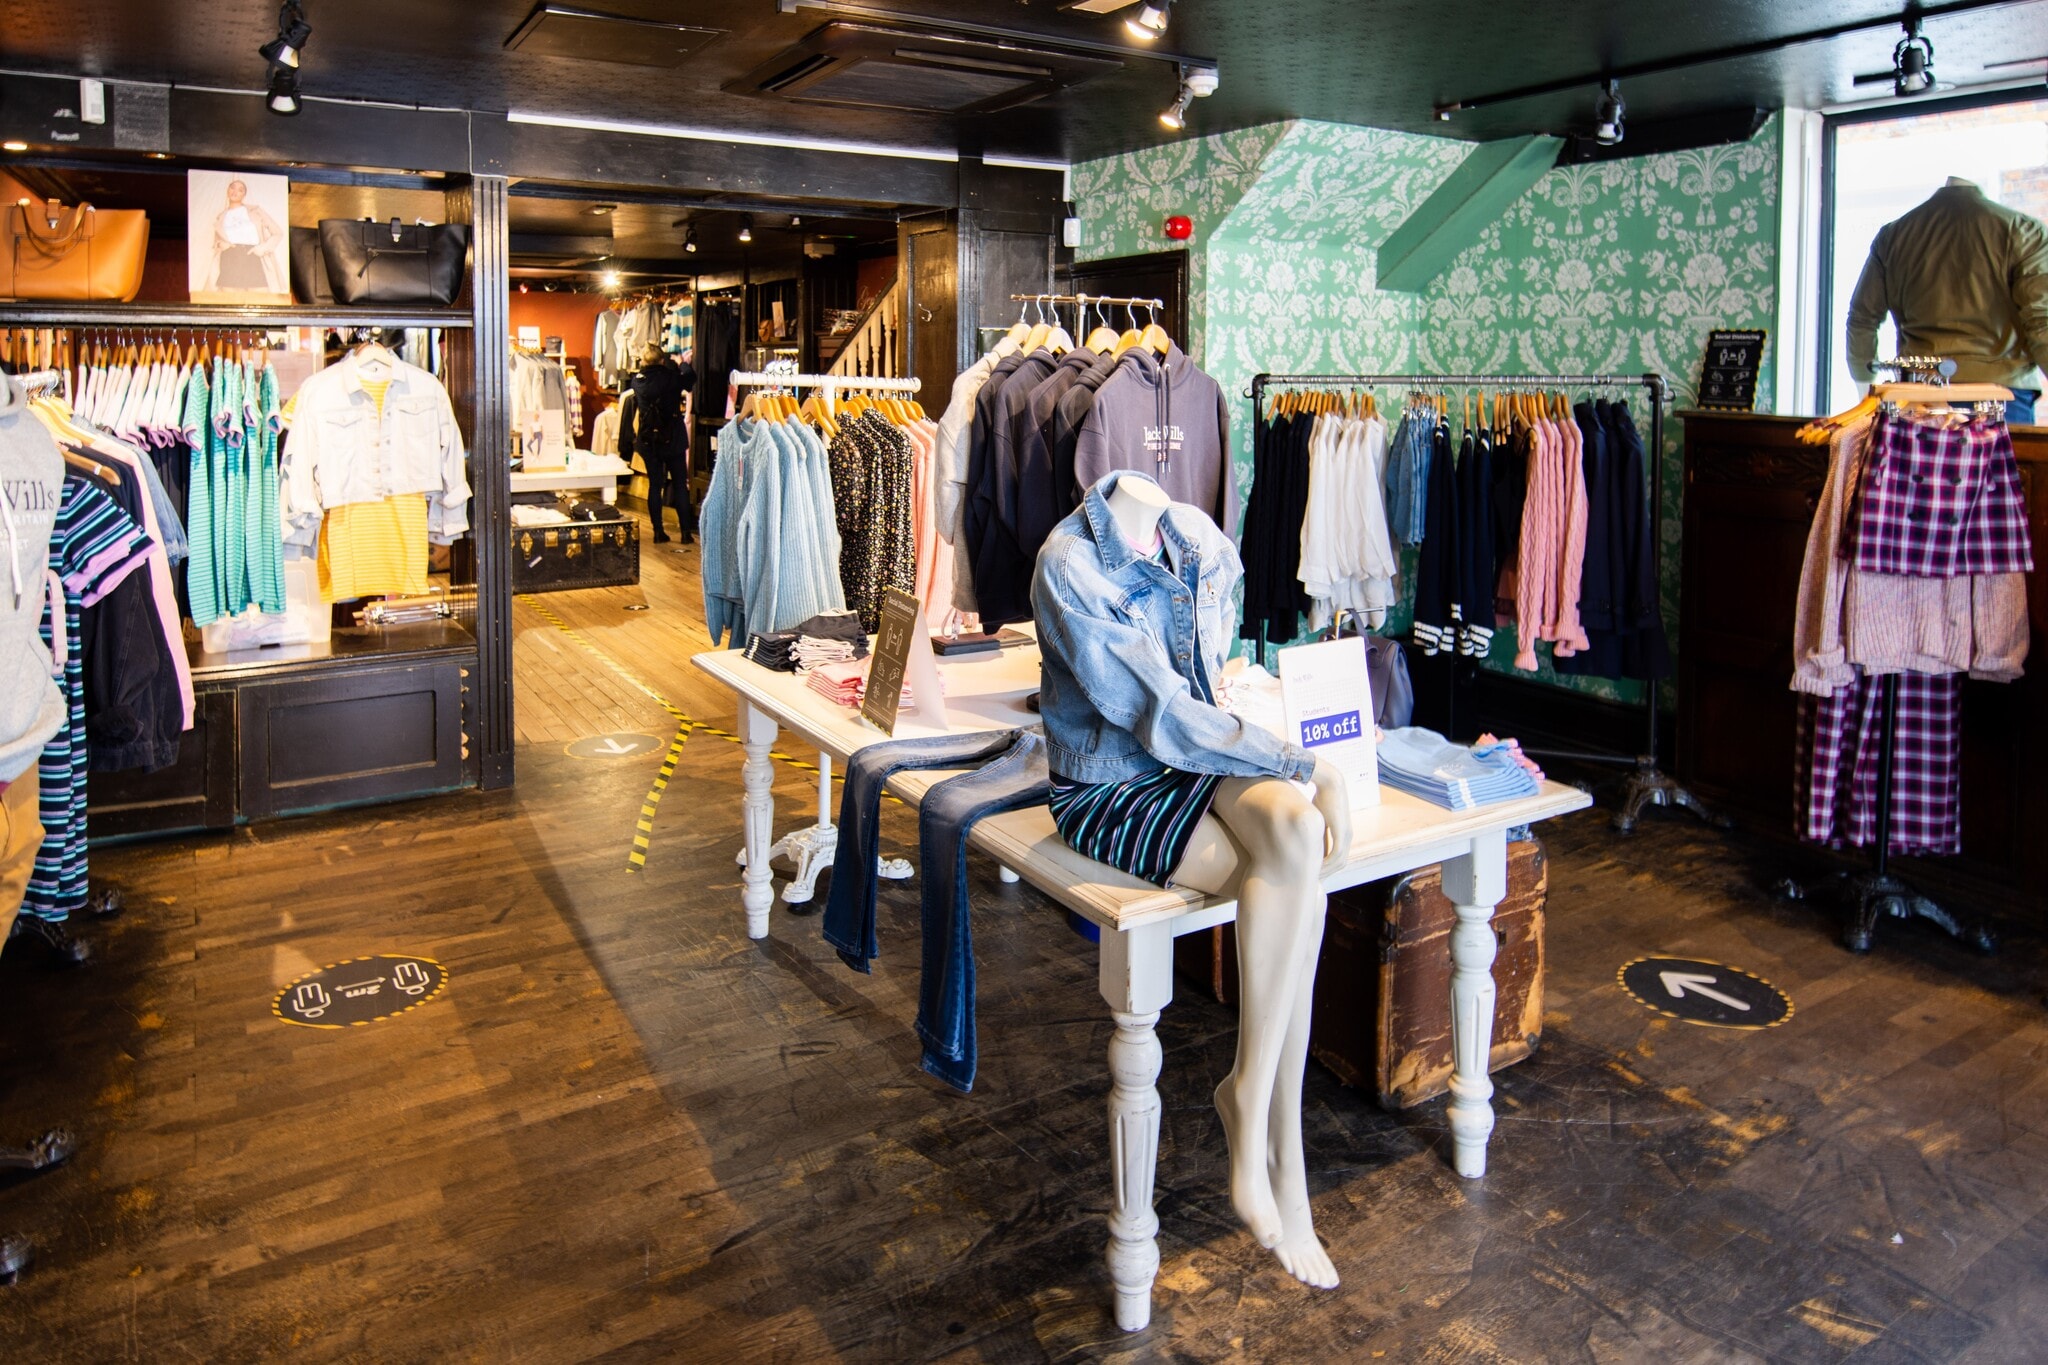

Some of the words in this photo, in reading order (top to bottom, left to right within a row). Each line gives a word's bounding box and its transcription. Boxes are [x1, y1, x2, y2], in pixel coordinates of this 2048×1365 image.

[1143, 425, 1162, 447] Jack
[12, 514, 49, 526] RITAIN
[1303, 723, 1330, 743] 10%
[1333, 716, 1358, 737] off
[345, 984, 381, 998] 2m
